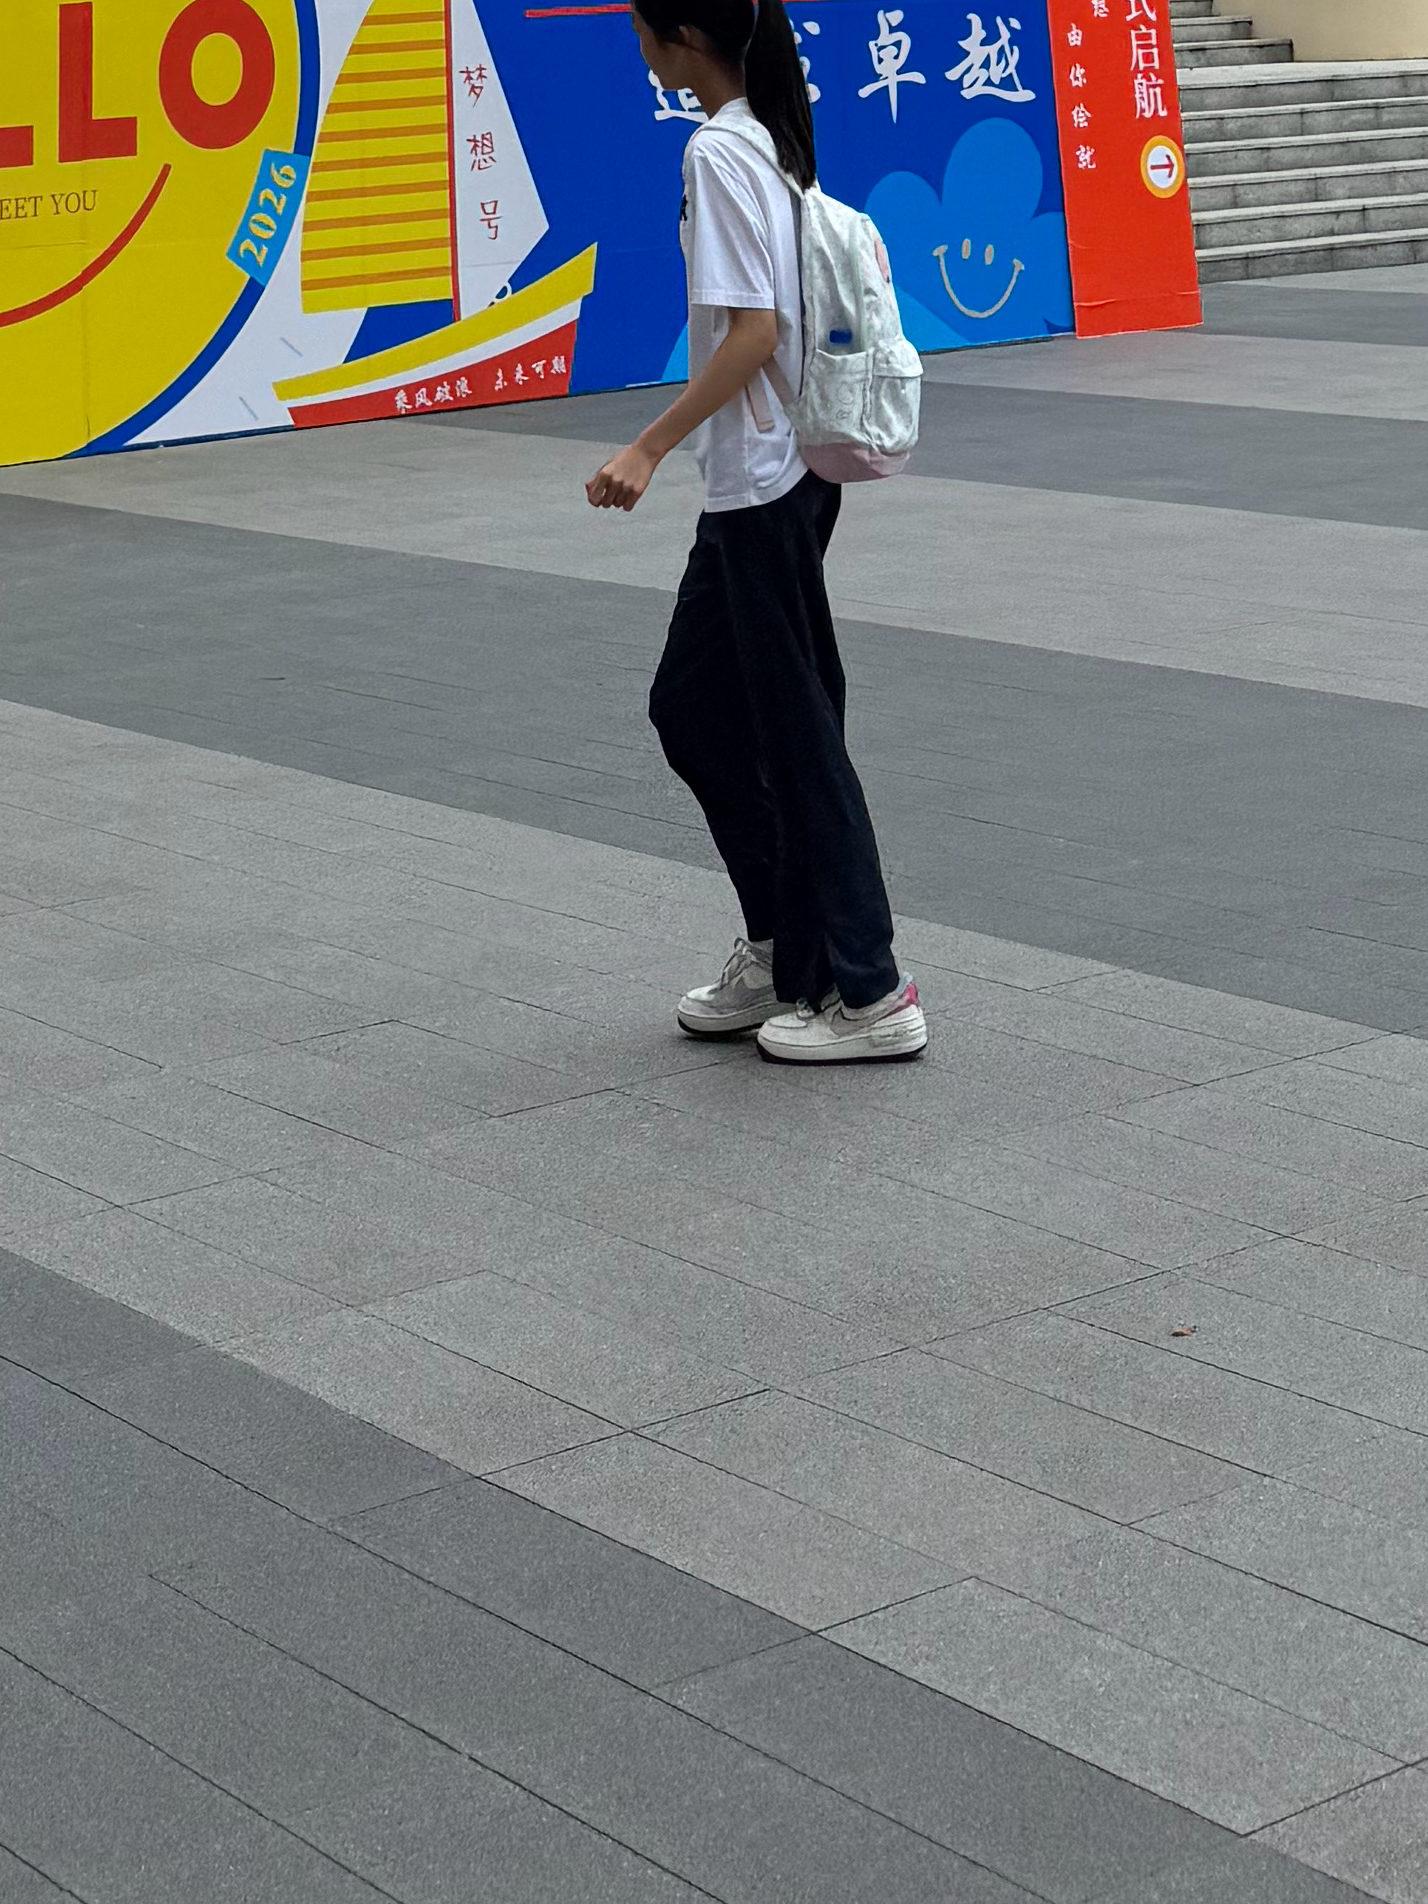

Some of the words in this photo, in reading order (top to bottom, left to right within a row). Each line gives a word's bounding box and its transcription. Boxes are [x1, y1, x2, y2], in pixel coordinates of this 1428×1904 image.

[50, 189, 98, 216] YOU
[459, 63, 503, 240] 梦想号
[238, 161, 297, 268] 2026
